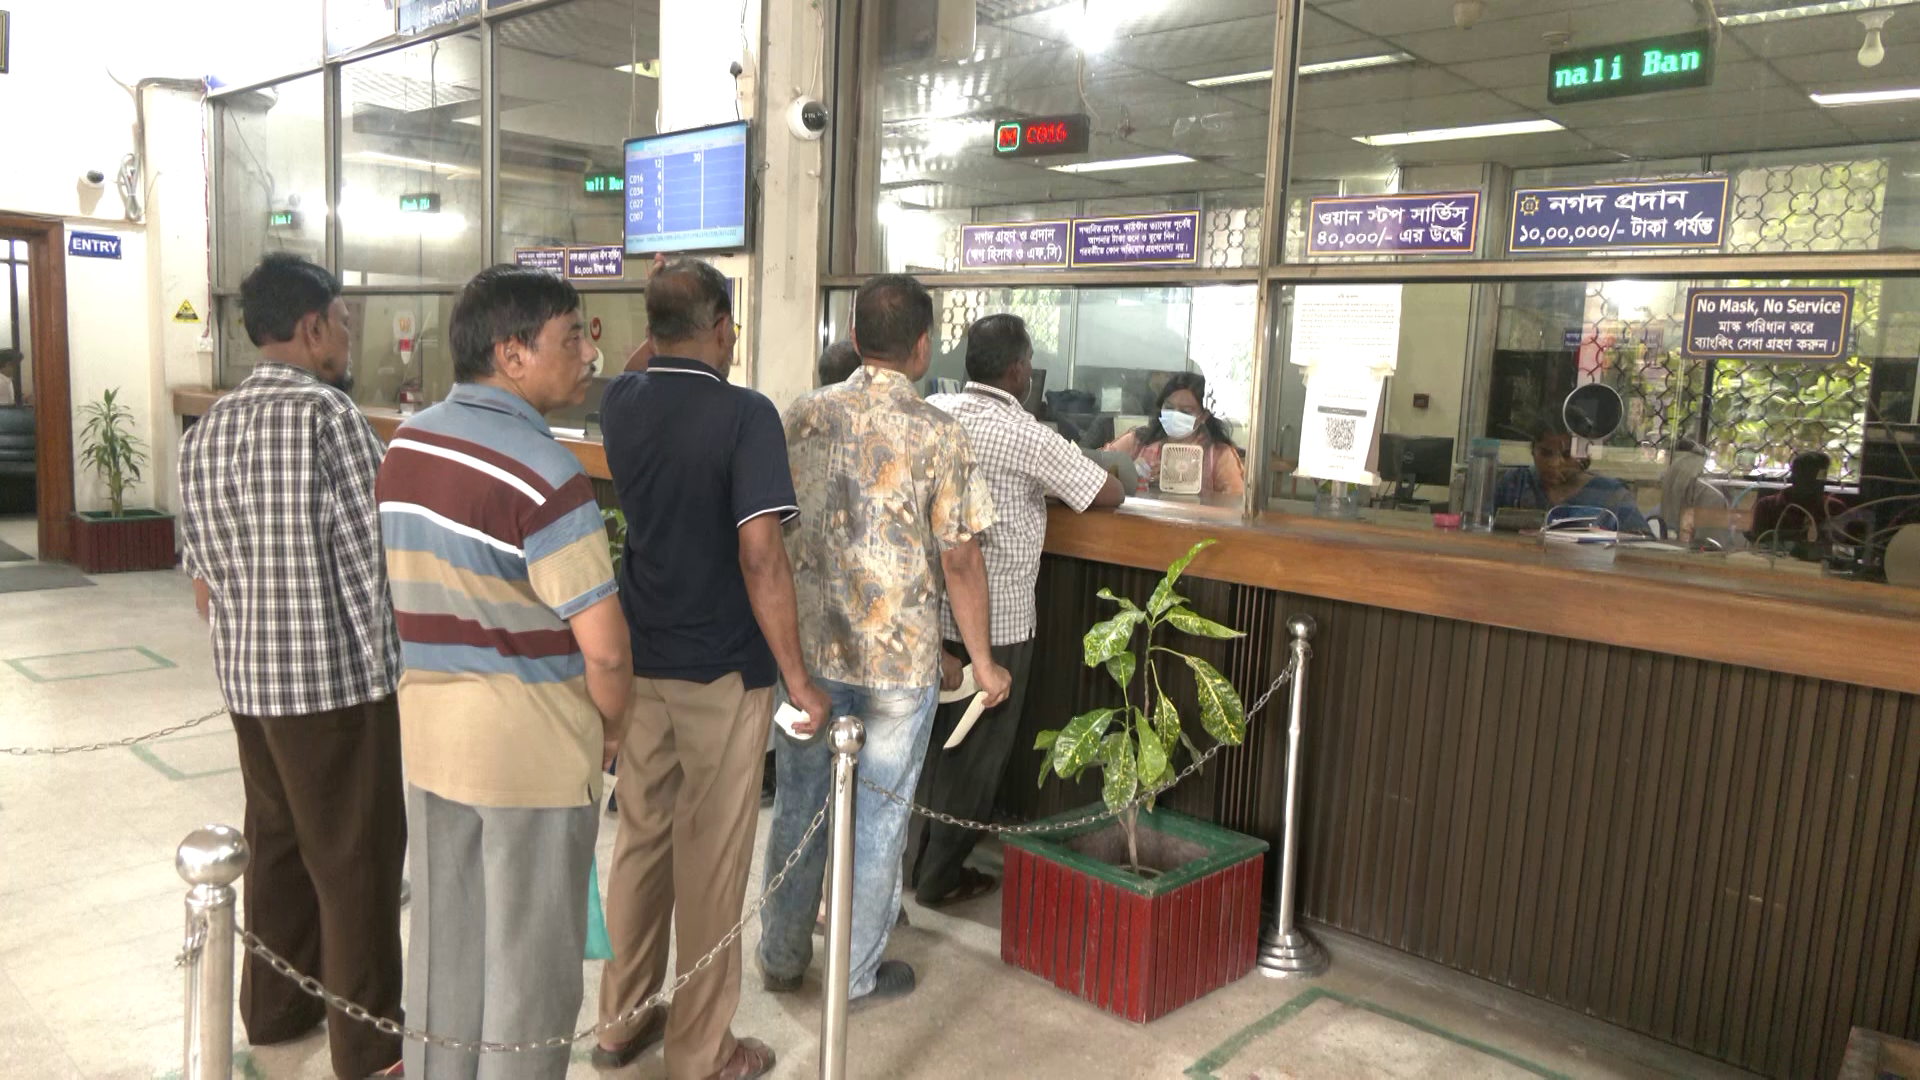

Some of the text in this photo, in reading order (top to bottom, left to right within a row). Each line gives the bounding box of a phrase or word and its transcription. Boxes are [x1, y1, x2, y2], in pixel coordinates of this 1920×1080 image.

[1555, 50, 1700, 88] nali Ban
[1026, 122, 1067, 144] C016
[654, 159, 662, 168] 12
[693, 153, 701, 163] 30
[629, 174, 644, 184] C016
[654, 197, 662, 207] 11
[1548, 189, 1688, 215] নগদ প্রদান
[1319, 201, 1469, 226] ওয়ান স্টপ সার্ভিস
[974, 228, 1056, 244] নগদ গ্রহণ ও প্রদান
[1519, 211, 1715, 245] ১০,০০,০০০/- টাকা পর্যন্ত
[72, 236, 118, 254] ENTRY
[1317, 227, 1393, 248] ৪০,০০০/-
[1399, 228, 1425, 244] এর
[1016, 248, 1024, 259] ও
[1697, 298, 1841, 316] No Mask, No Service
[1746, 317, 1786, 334] পরিধান
[1789, 321, 1815, 334] করে
[1694, 333, 1734, 350] ব্যাংকিং
[1737, 336, 1763, 350] সেবা
[1765, 337, 1793, 352] গ্রহণ
